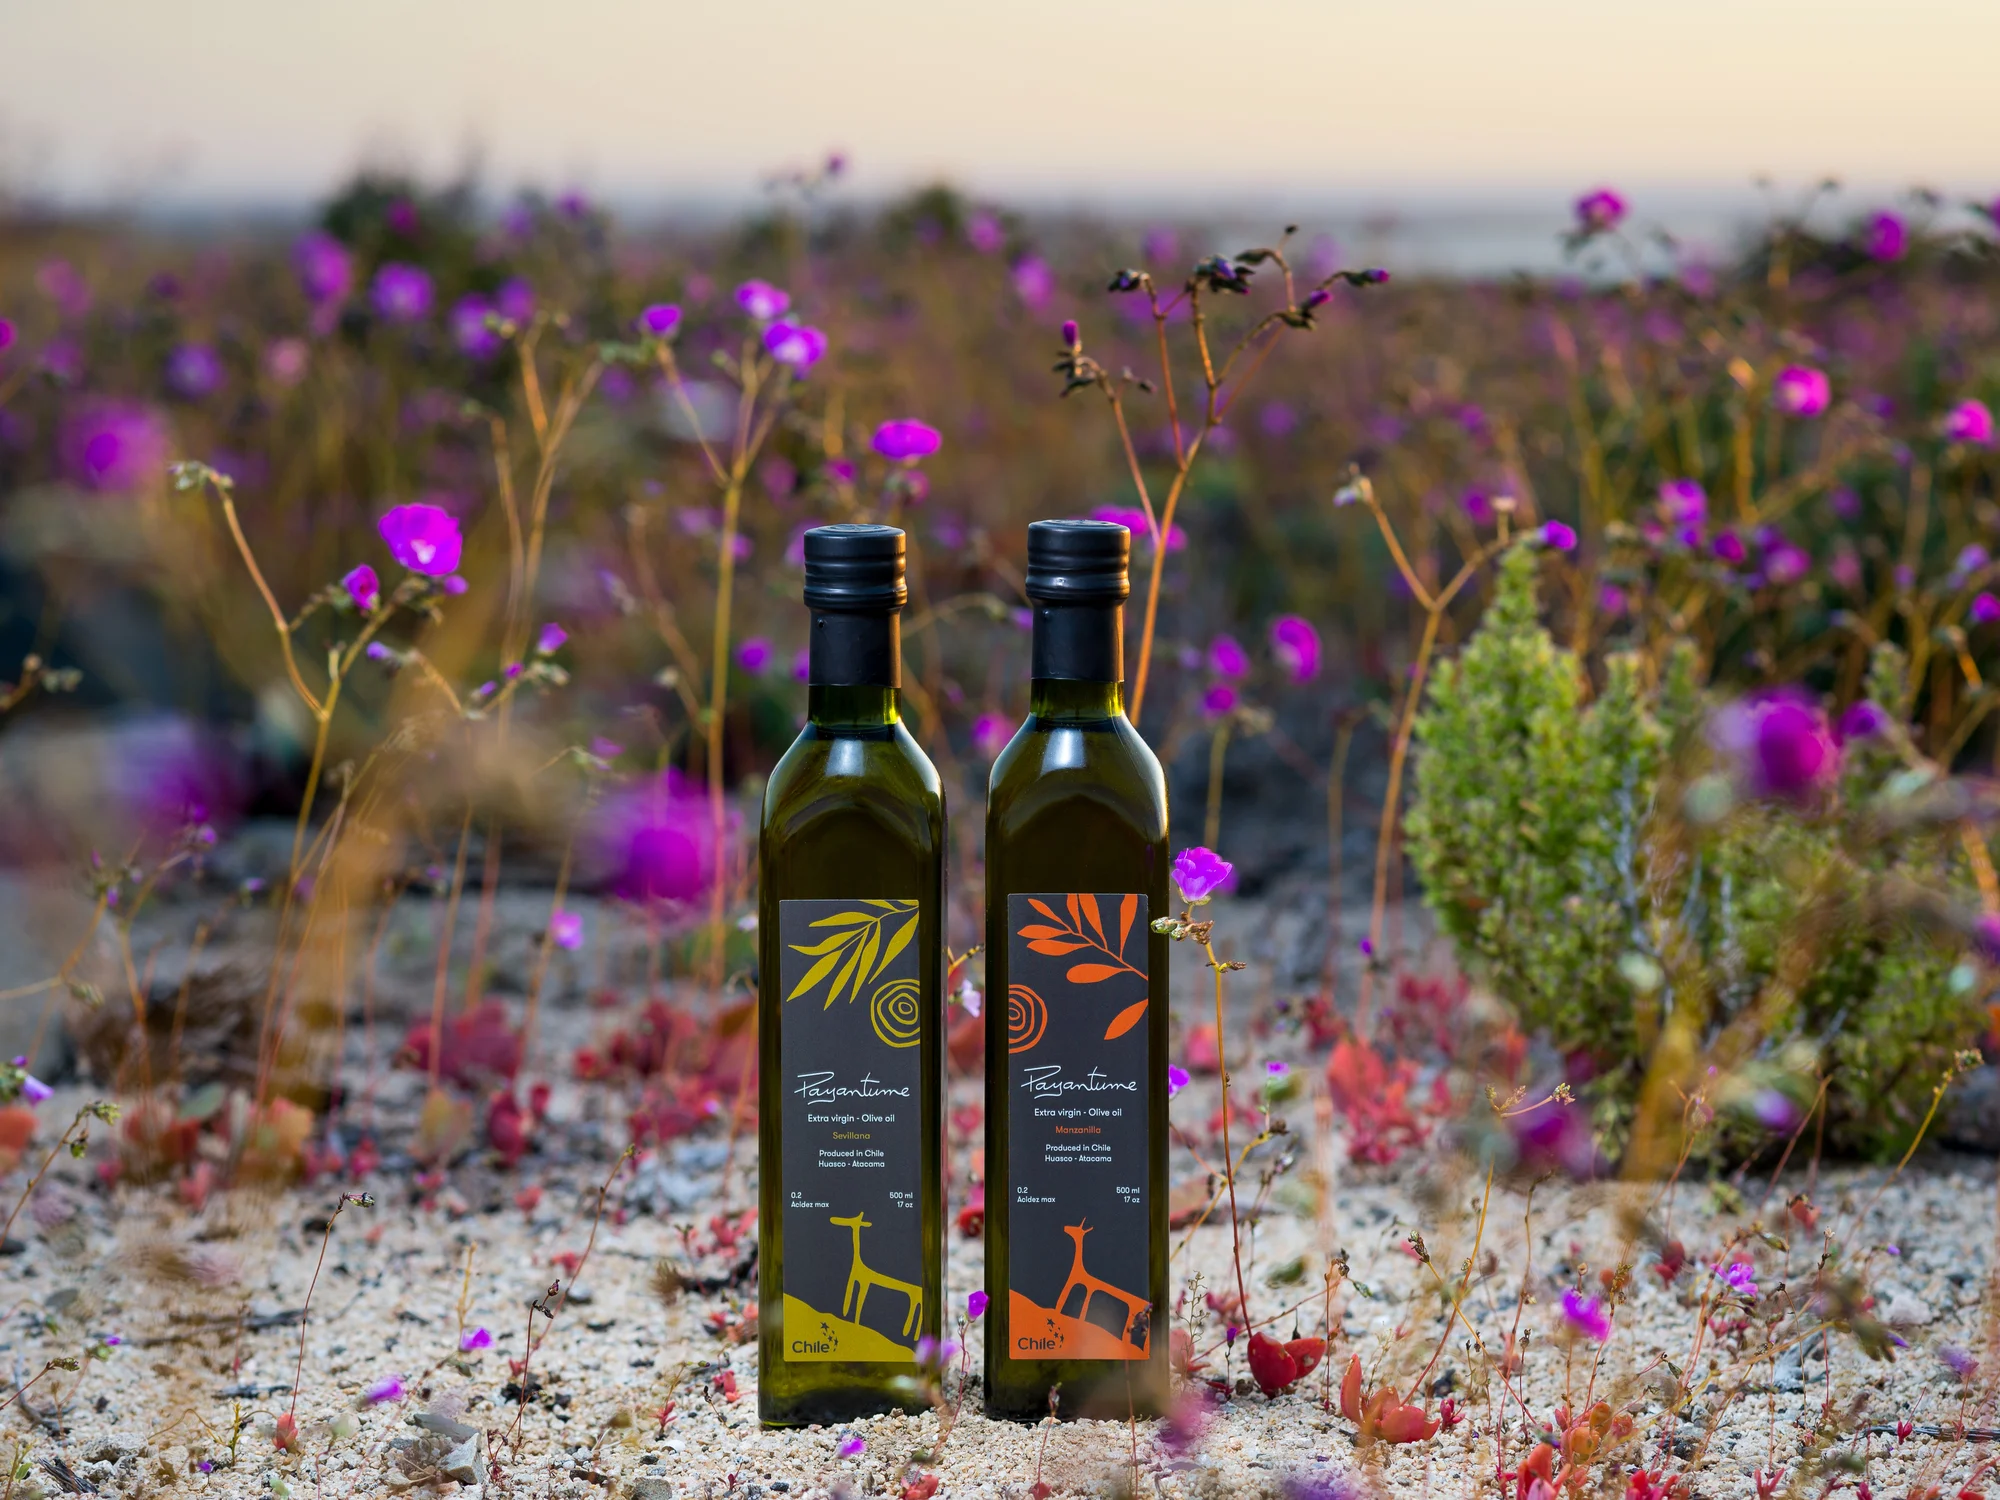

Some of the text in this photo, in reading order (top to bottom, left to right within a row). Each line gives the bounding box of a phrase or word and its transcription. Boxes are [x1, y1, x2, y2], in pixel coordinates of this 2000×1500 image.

[1020, 1065, 1137, 1099] Payantume
[794, 1071, 910, 1105] Payantume
[1034, 1108, 1056, 1117] Extra
[1058, 1108, 1081, 1118] virgin
[1088, 1108, 1110, 1117] Olive
[1112, 1108, 1122, 1117] oil
[807, 1114, 829, 1122] Extra
[831, 1114, 855, 1124] virgin
[861, 1114, 883, 1122] Olive
[884, 1114, 895, 1122] oil
[1055, 1125, 1101, 1134] Manzanilla
[832, 1131, 871, 1140] Sevillana
[1045, 1144, 1111, 1152] Produced in Chile
[819, 1149, 884, 1157] Produced in Chile
[1044, 1154, 1073, 1162] Huasco
[1079, 1154, 1112, 1162] Atacama
[818, 1160, 846, 1168] Huasco
[852, 1160, 885, 1168] Atacama
[1017, 1186, 1028, 1194] 0.2
[1116, 1186, 1140, 1194] 500 ml
[790, 1191, 802, 1199] 0.2
[889, 1191, 913, 1199] 500 ml
[792, 1340, 830, 1353] Chile
[1017, 1337, 1056, 1350] Chile
